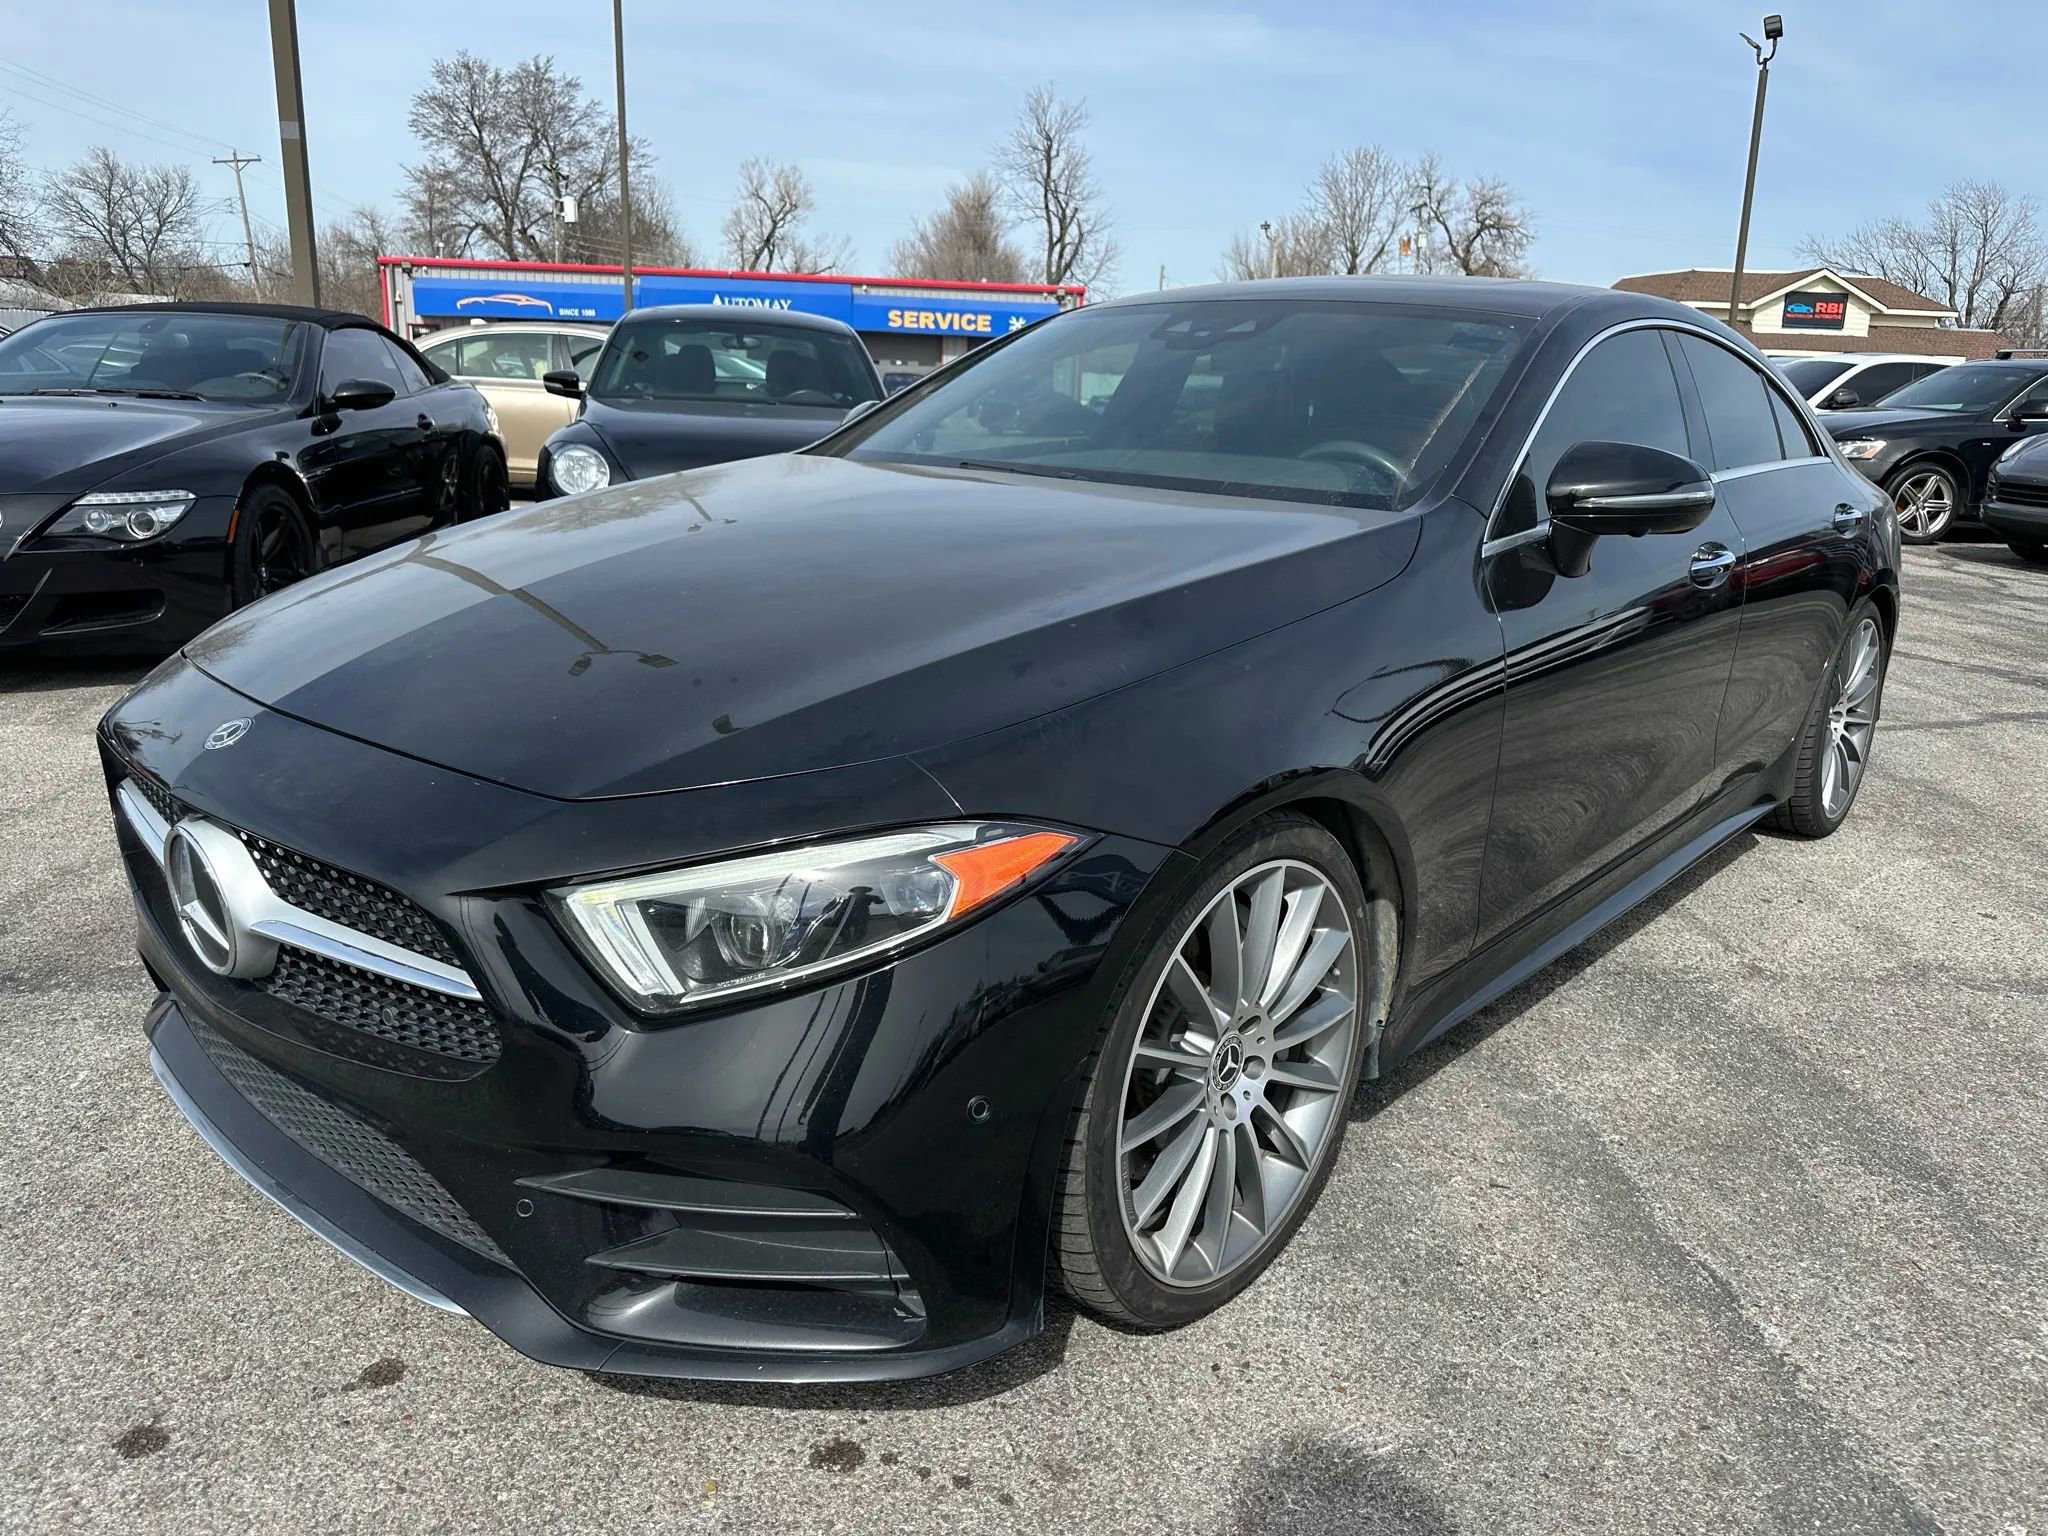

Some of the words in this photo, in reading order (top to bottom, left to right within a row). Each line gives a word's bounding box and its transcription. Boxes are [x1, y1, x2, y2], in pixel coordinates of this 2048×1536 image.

[559, 308, 579, 317] SINCE
[1815, 302, 1844, 314] RBI
[887, 309, 992, 332] SERVICE
